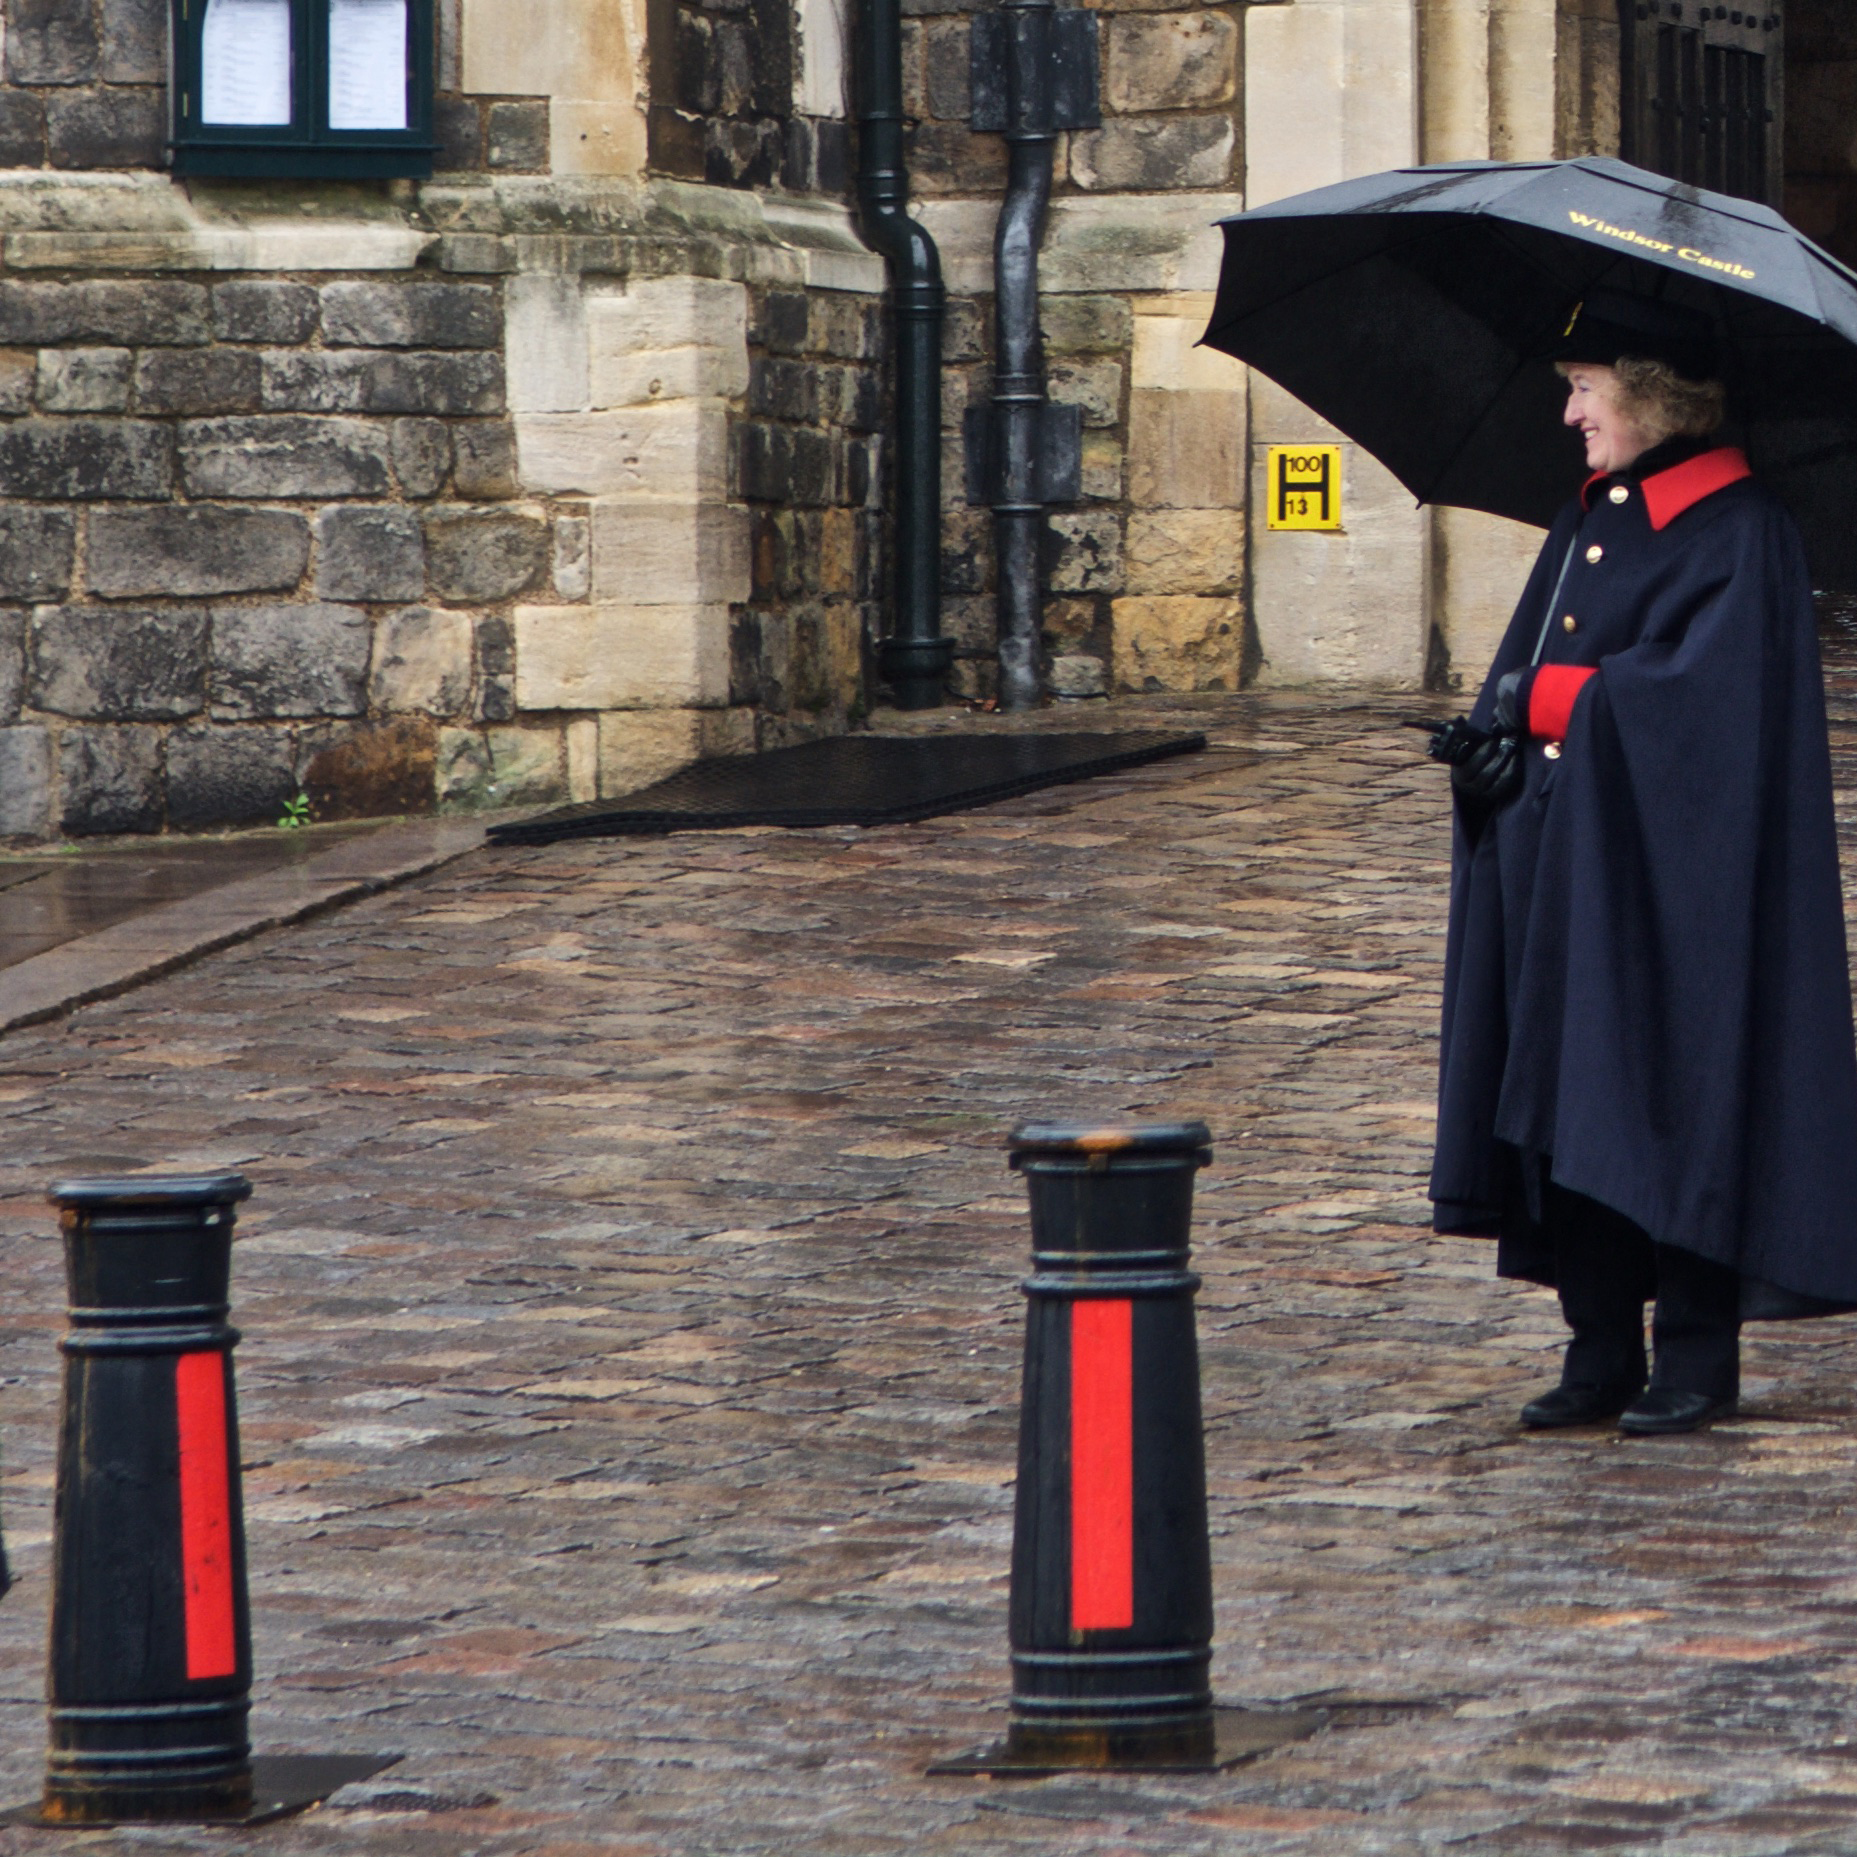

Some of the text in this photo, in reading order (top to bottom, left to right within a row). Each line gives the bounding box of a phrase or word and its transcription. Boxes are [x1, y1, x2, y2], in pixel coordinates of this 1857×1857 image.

[1568, 210, 1756, 280] Windsor Castle
[1286, 456, 1322, 473] 100
[1286, 498, 1308, 516] 13
